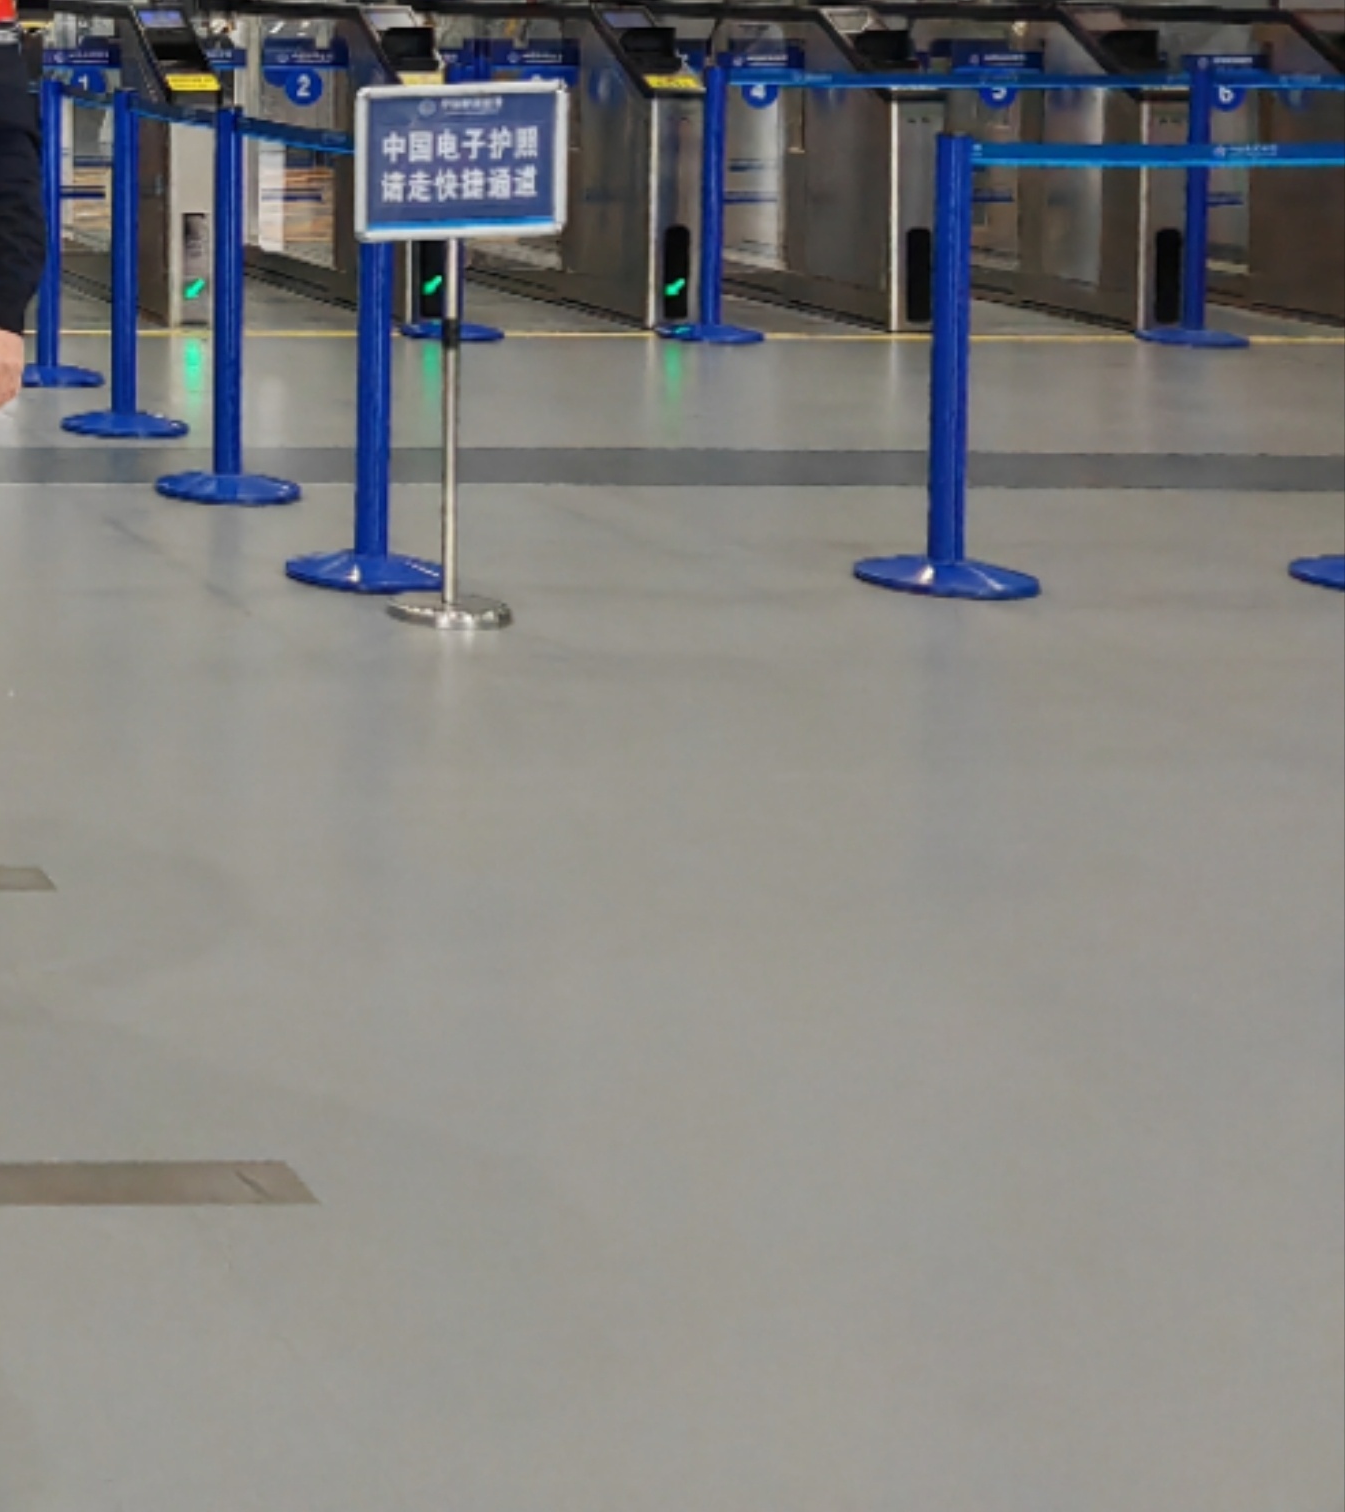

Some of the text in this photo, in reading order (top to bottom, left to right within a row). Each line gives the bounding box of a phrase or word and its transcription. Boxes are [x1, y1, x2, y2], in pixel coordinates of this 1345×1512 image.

[296, 75, 310, 97] 2
[382, 126, 539, 164] 中国电子护照
[381, 165, 538, 204] 请走快捷通道
